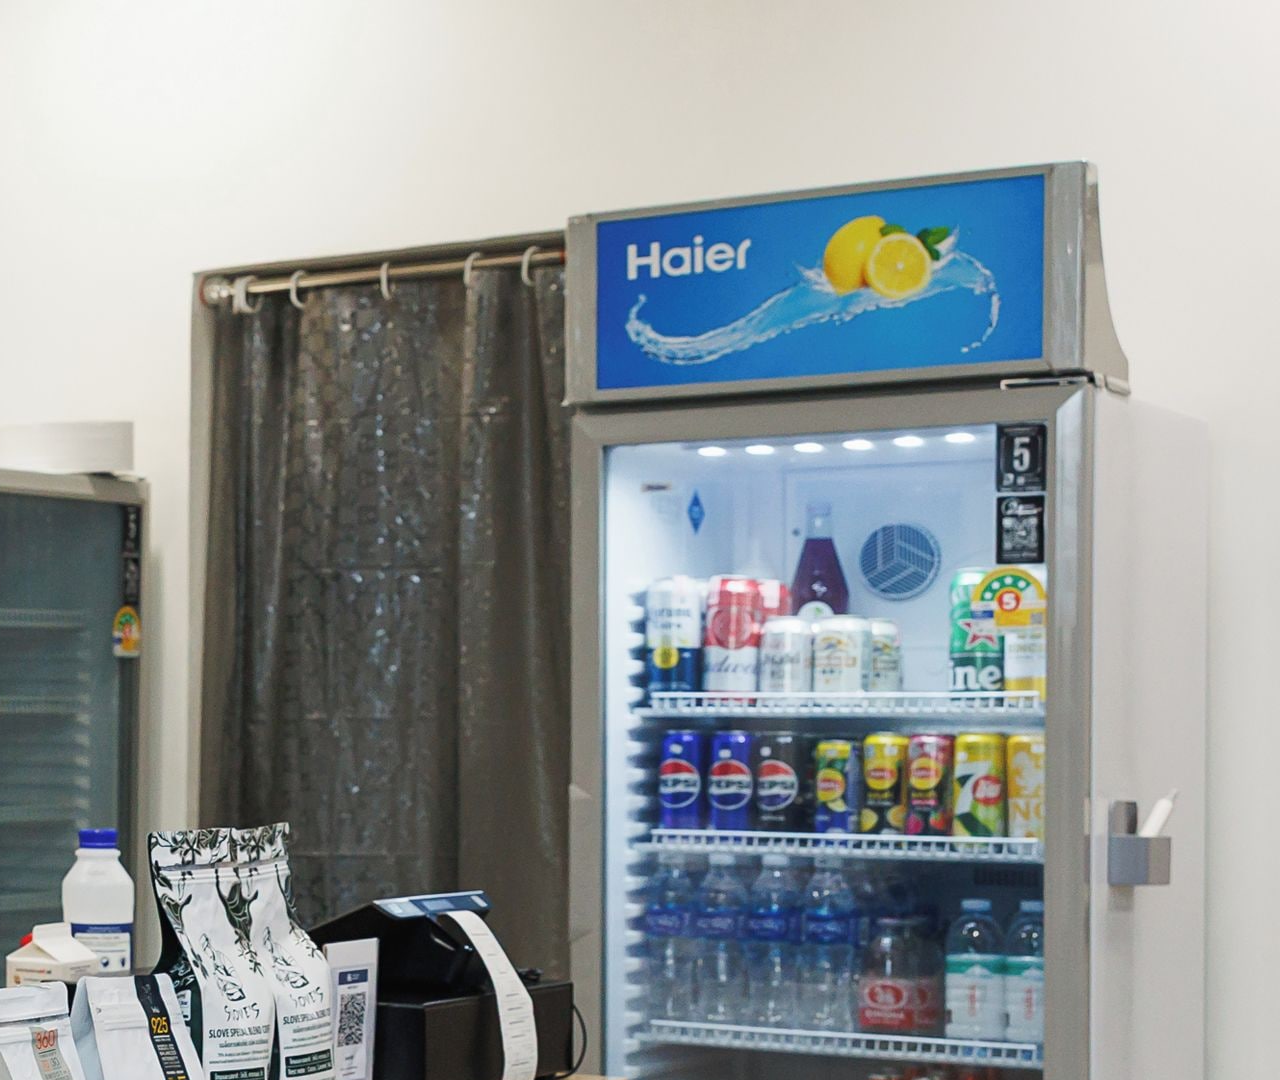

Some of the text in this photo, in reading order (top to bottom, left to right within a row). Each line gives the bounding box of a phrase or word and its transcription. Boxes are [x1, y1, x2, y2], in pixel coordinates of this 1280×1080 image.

[626, 234, 752, 282] Haier
[1013, 437, 1031, 472] 5
[151, 1016, 169, 1034] 925
[208, 1028, 230, 1039] SLOVE
[35, 1030, 56, 1050] 360
